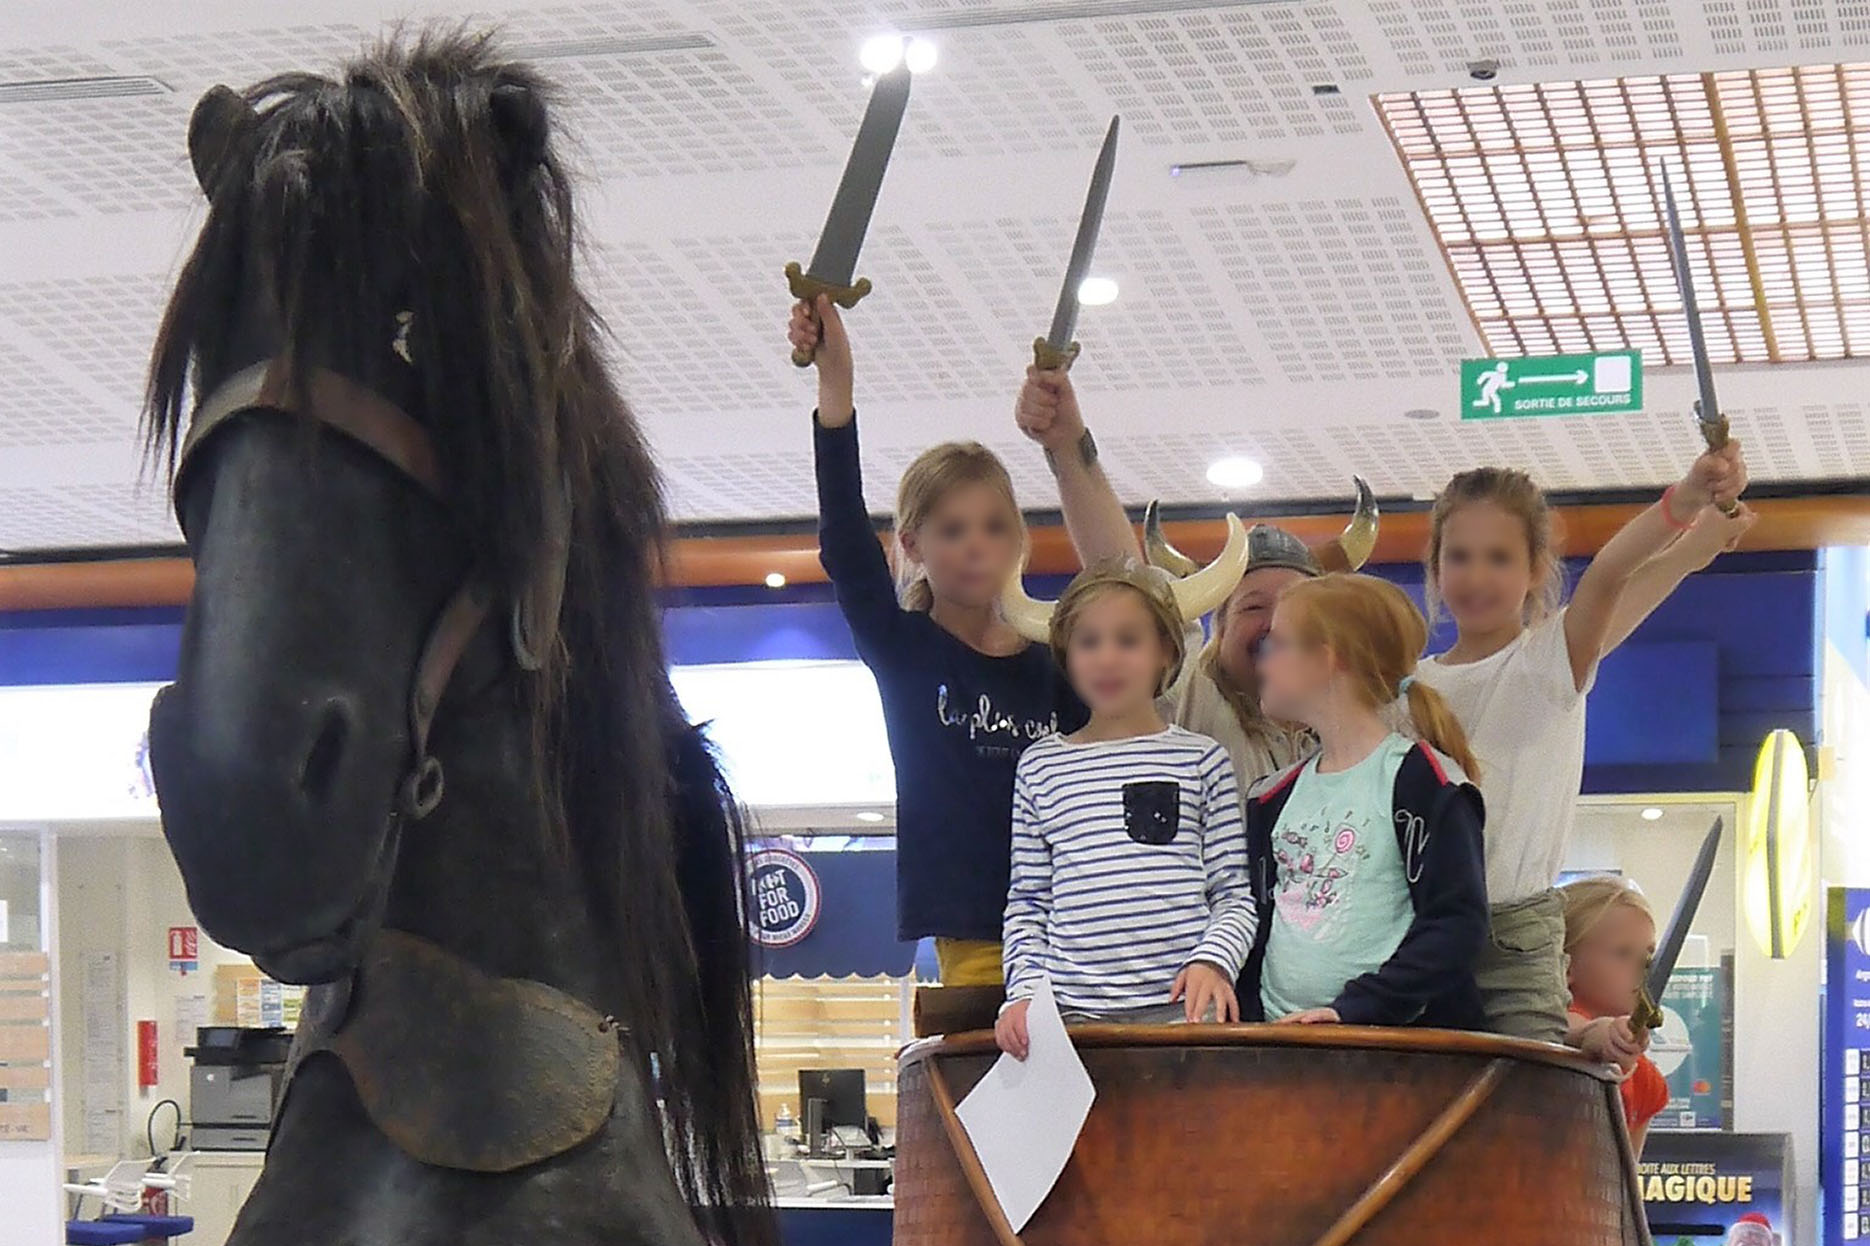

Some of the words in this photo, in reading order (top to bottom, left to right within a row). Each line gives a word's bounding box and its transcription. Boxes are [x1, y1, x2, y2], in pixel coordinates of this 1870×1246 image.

[1514, 399, 1555, 410] SORTIE
[1558, 397, 1572, 407] DE
[1576, 393, 1631, 407] SECOURS
[758, 887, 789, 910] FOR
[760, 901, 800, 928] FOOD
[1660, 1163, 1679, 1175] AUX
